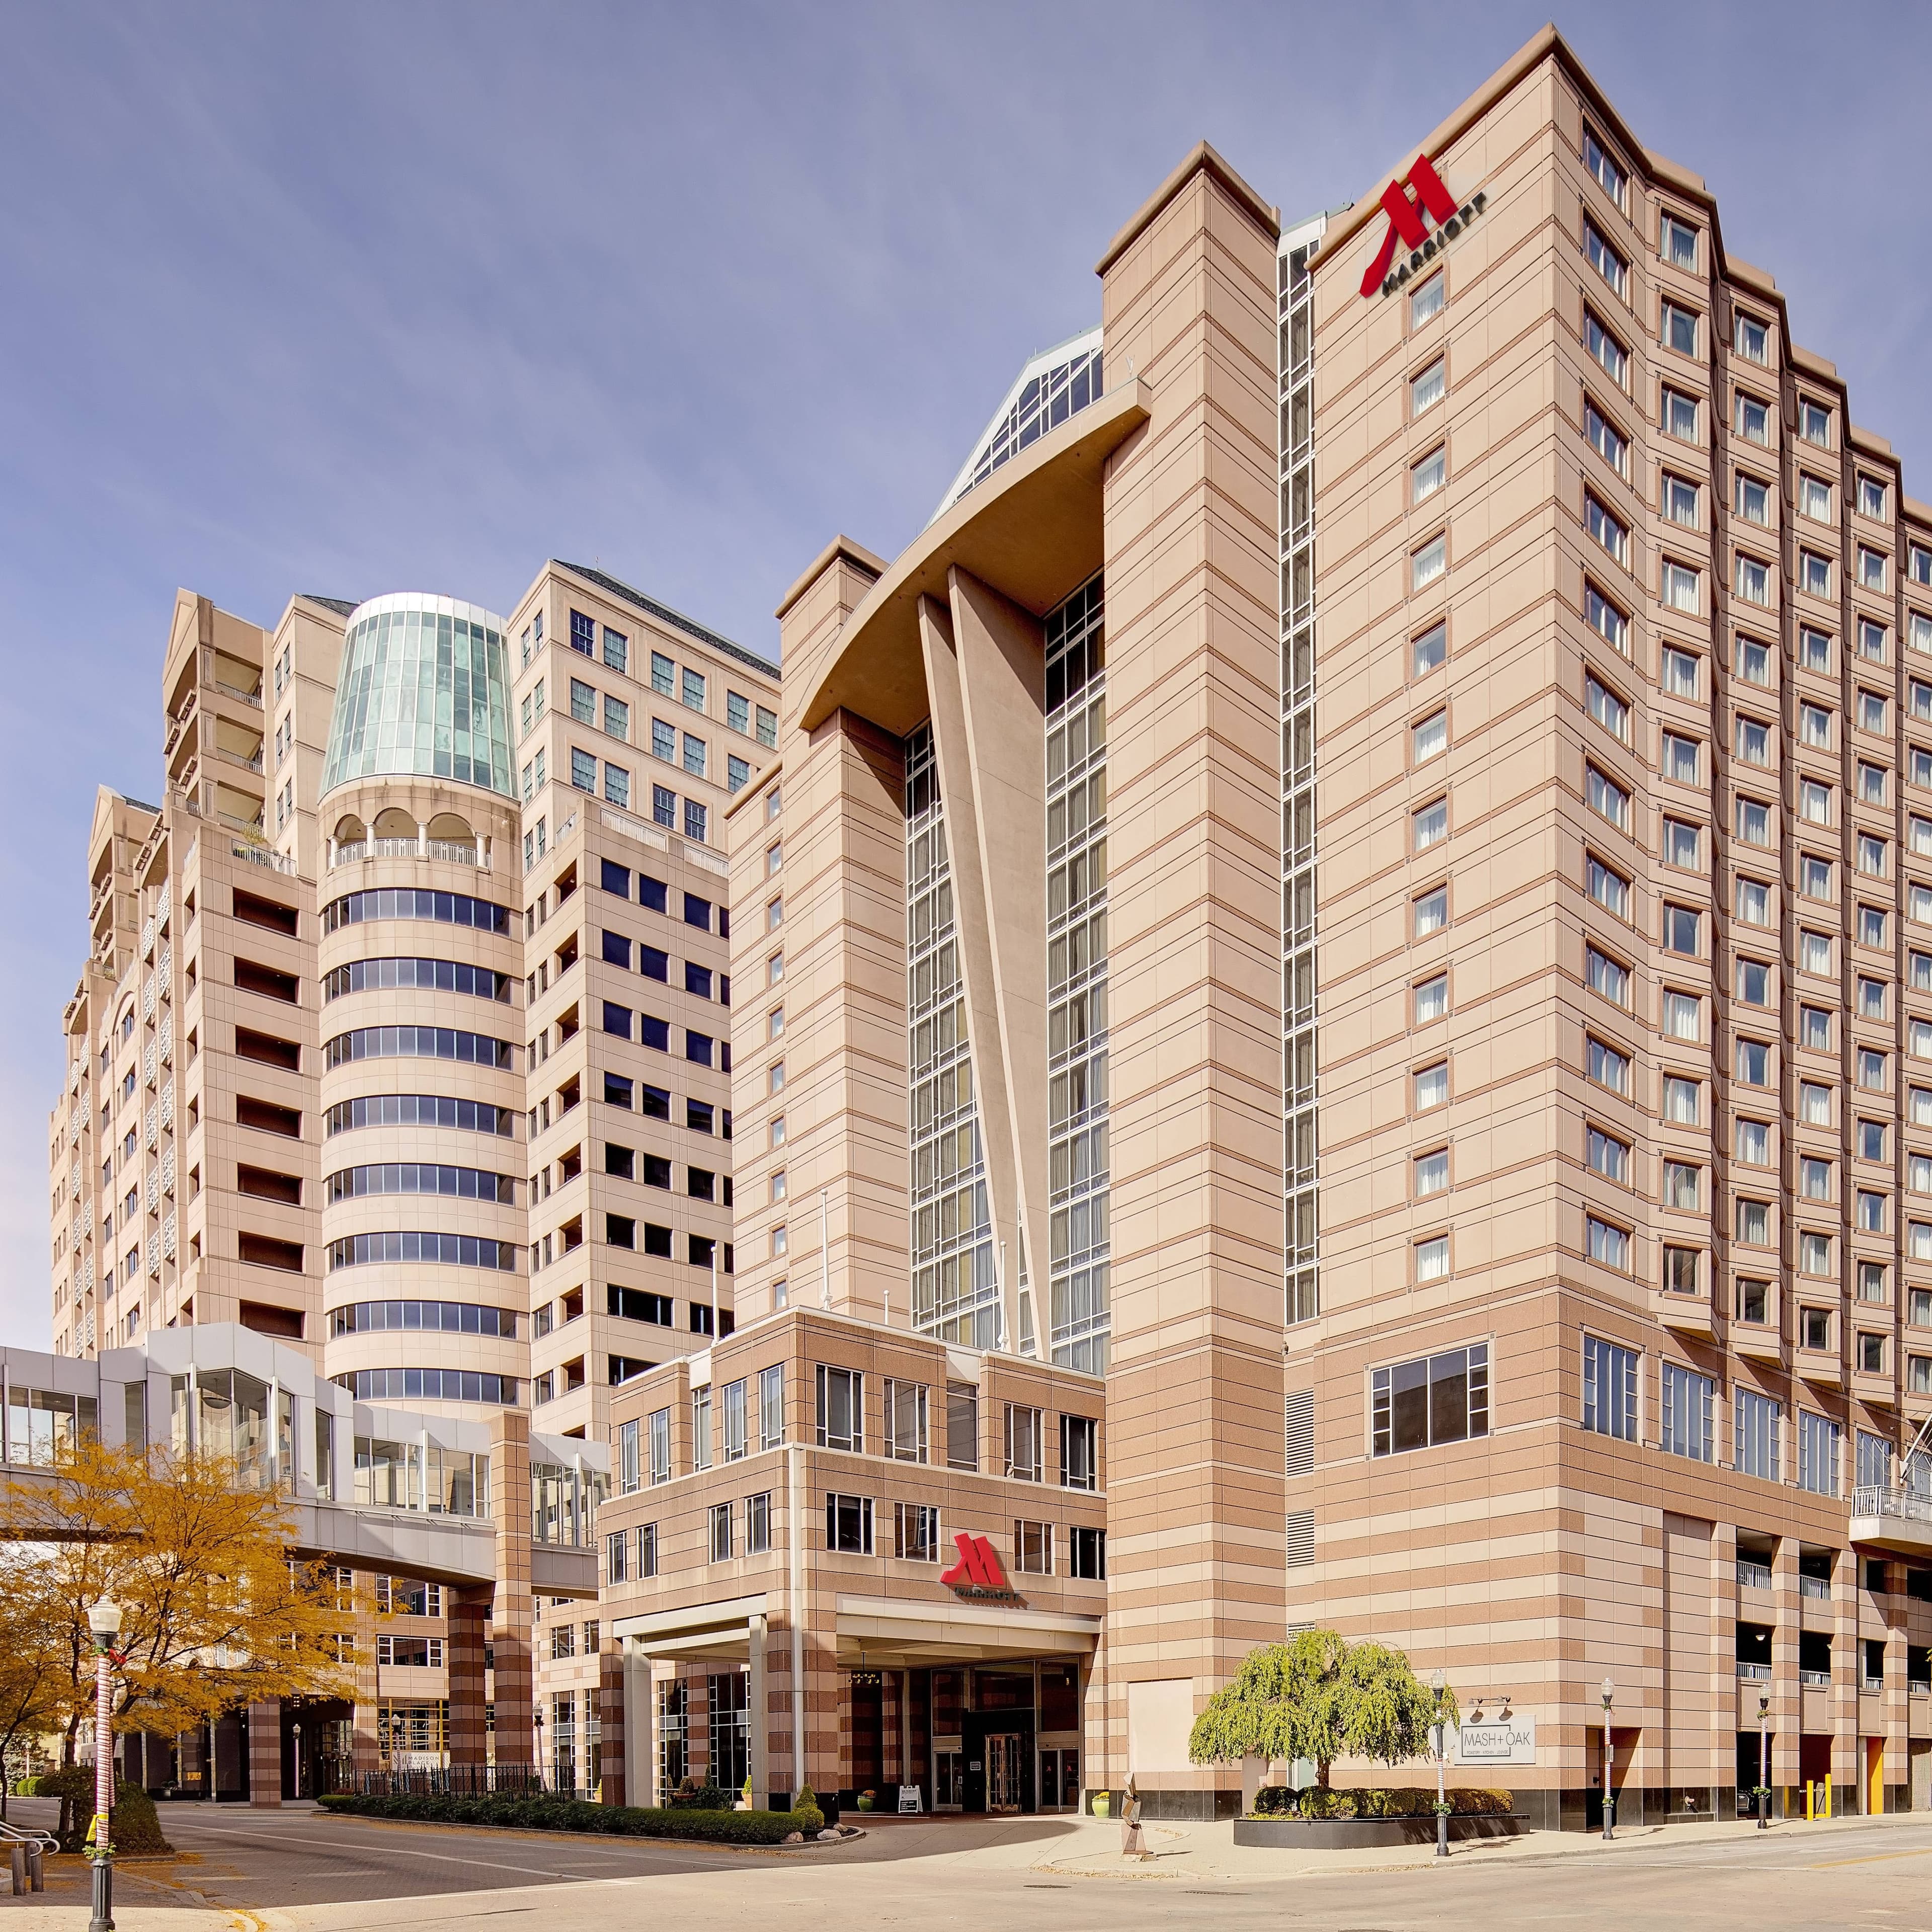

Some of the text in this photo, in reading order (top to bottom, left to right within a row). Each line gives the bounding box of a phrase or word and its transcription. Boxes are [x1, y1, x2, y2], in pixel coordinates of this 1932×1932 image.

[1382, 192, 1486, 298] MARRIOTT
[955, 1587, 1020, 1601] MARRIOTT
[1464, 1733, 1496, 1746] MASH
[1506, 1731, 1530, 1745] OAK
